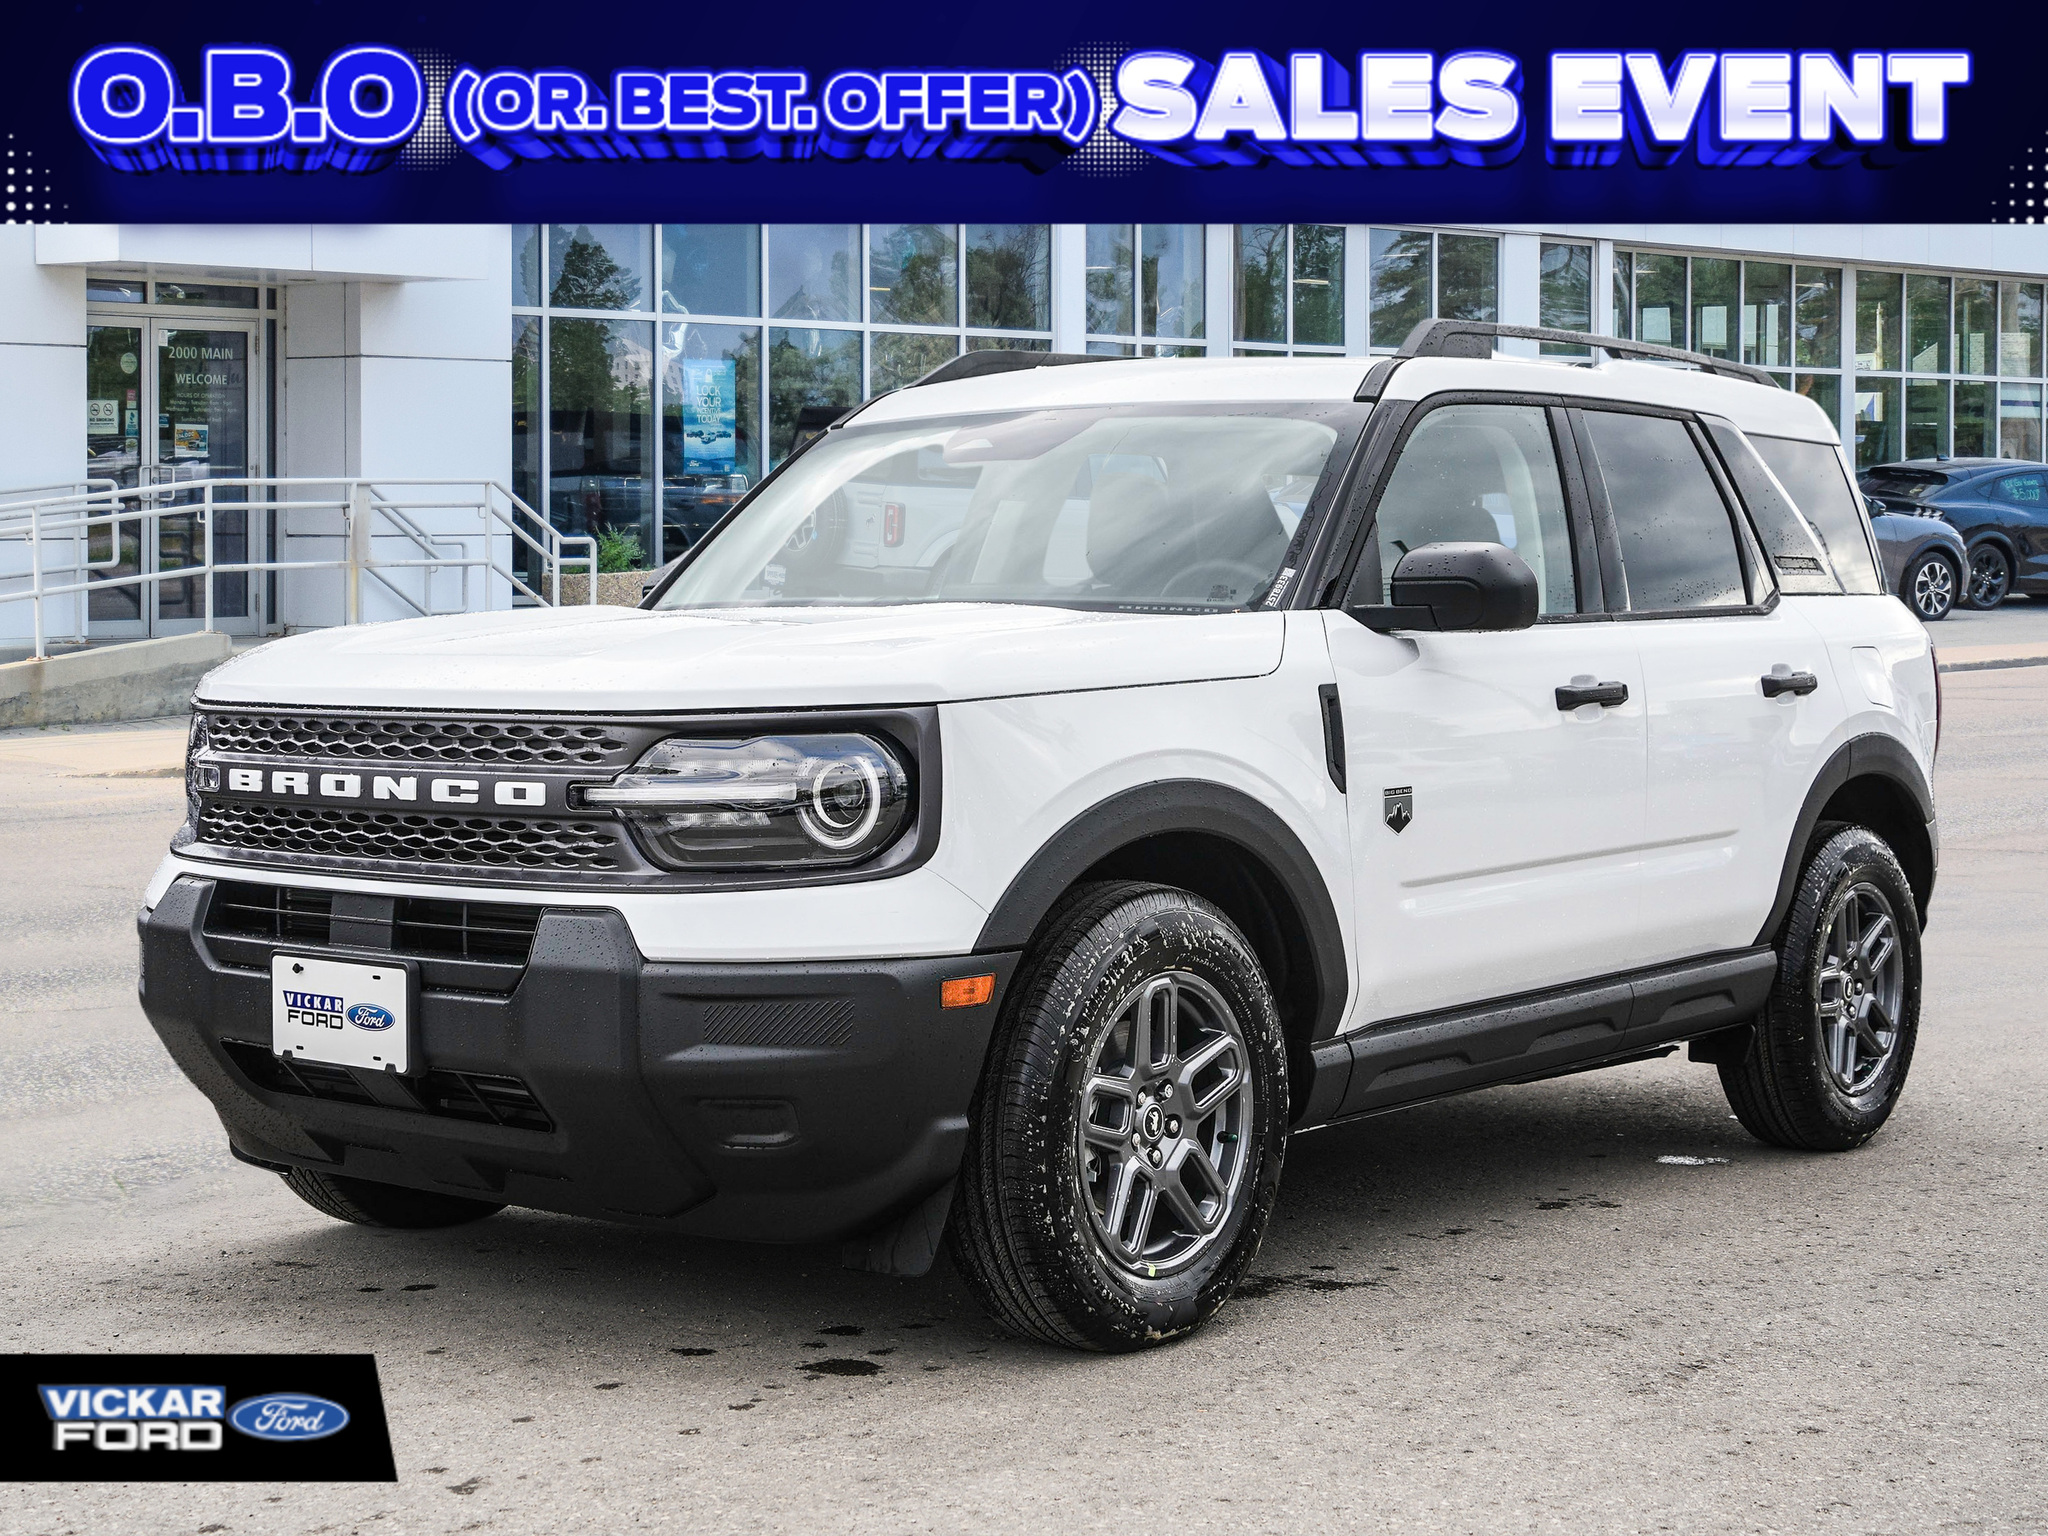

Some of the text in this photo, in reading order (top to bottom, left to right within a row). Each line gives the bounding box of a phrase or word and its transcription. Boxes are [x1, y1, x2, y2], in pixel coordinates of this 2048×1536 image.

[168, 346, 234, 360] 2000 MAIN
[175, 373, 228, 386] WELCOME
[696, 385, 721, 396] LOCK
[696, 396, 721, 407] YOUR
[697, 414, 721, 424] TODAY
[228, 768, 547, 806] BRONCO
[286, 992, 343, 1012] VICKAR
[288, 1009, 344, 1030] FORD
[355, 1006, 385, 1028] Ford
